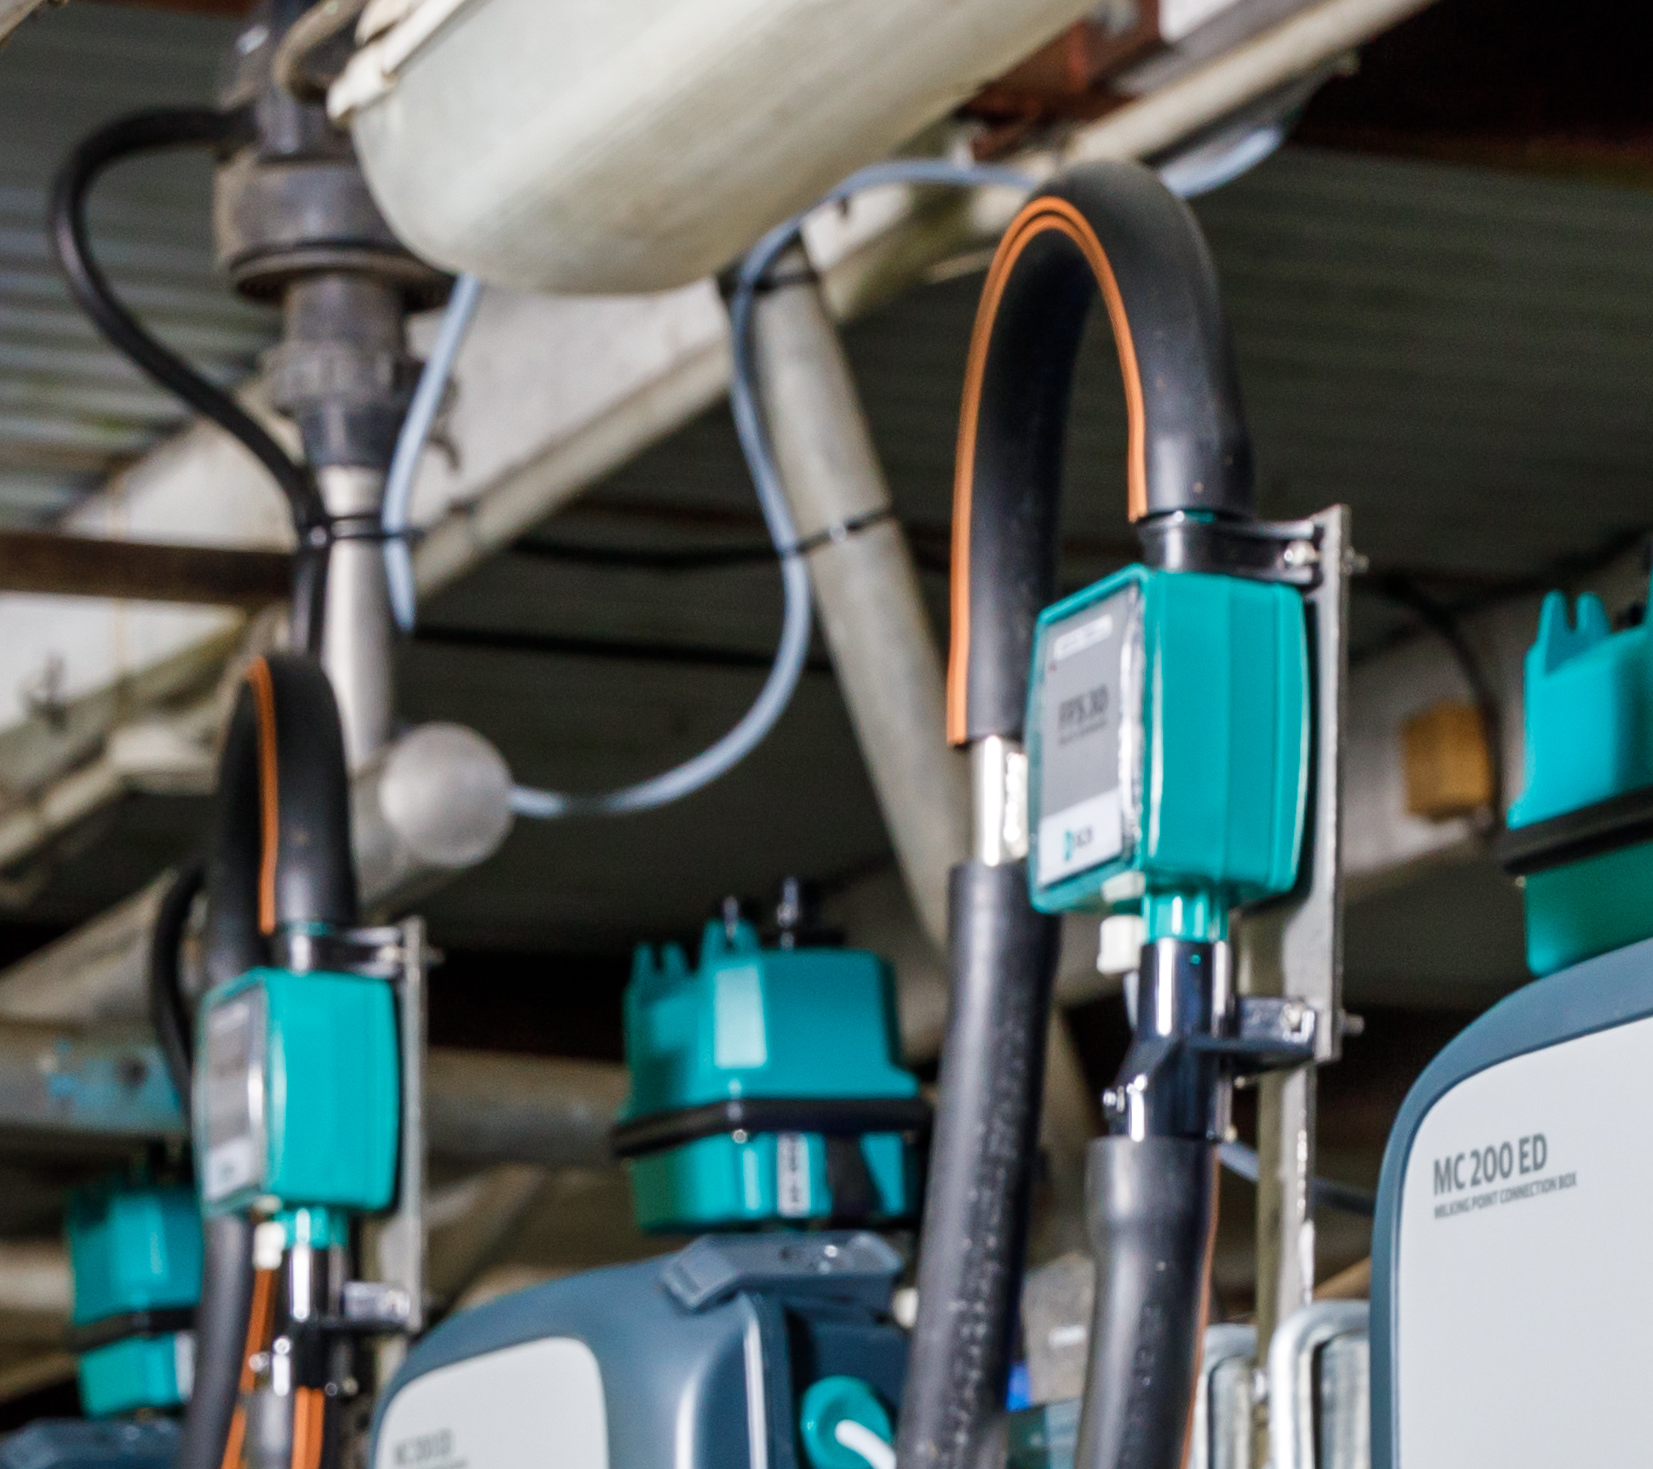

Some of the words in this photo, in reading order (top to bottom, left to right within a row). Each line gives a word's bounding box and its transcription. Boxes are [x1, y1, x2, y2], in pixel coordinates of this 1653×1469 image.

[1434, 1153, 1465, 1196] MC
[1470, 1141, 1514, 1187] 200
[1518, 1132, 1548, 1174] ED
